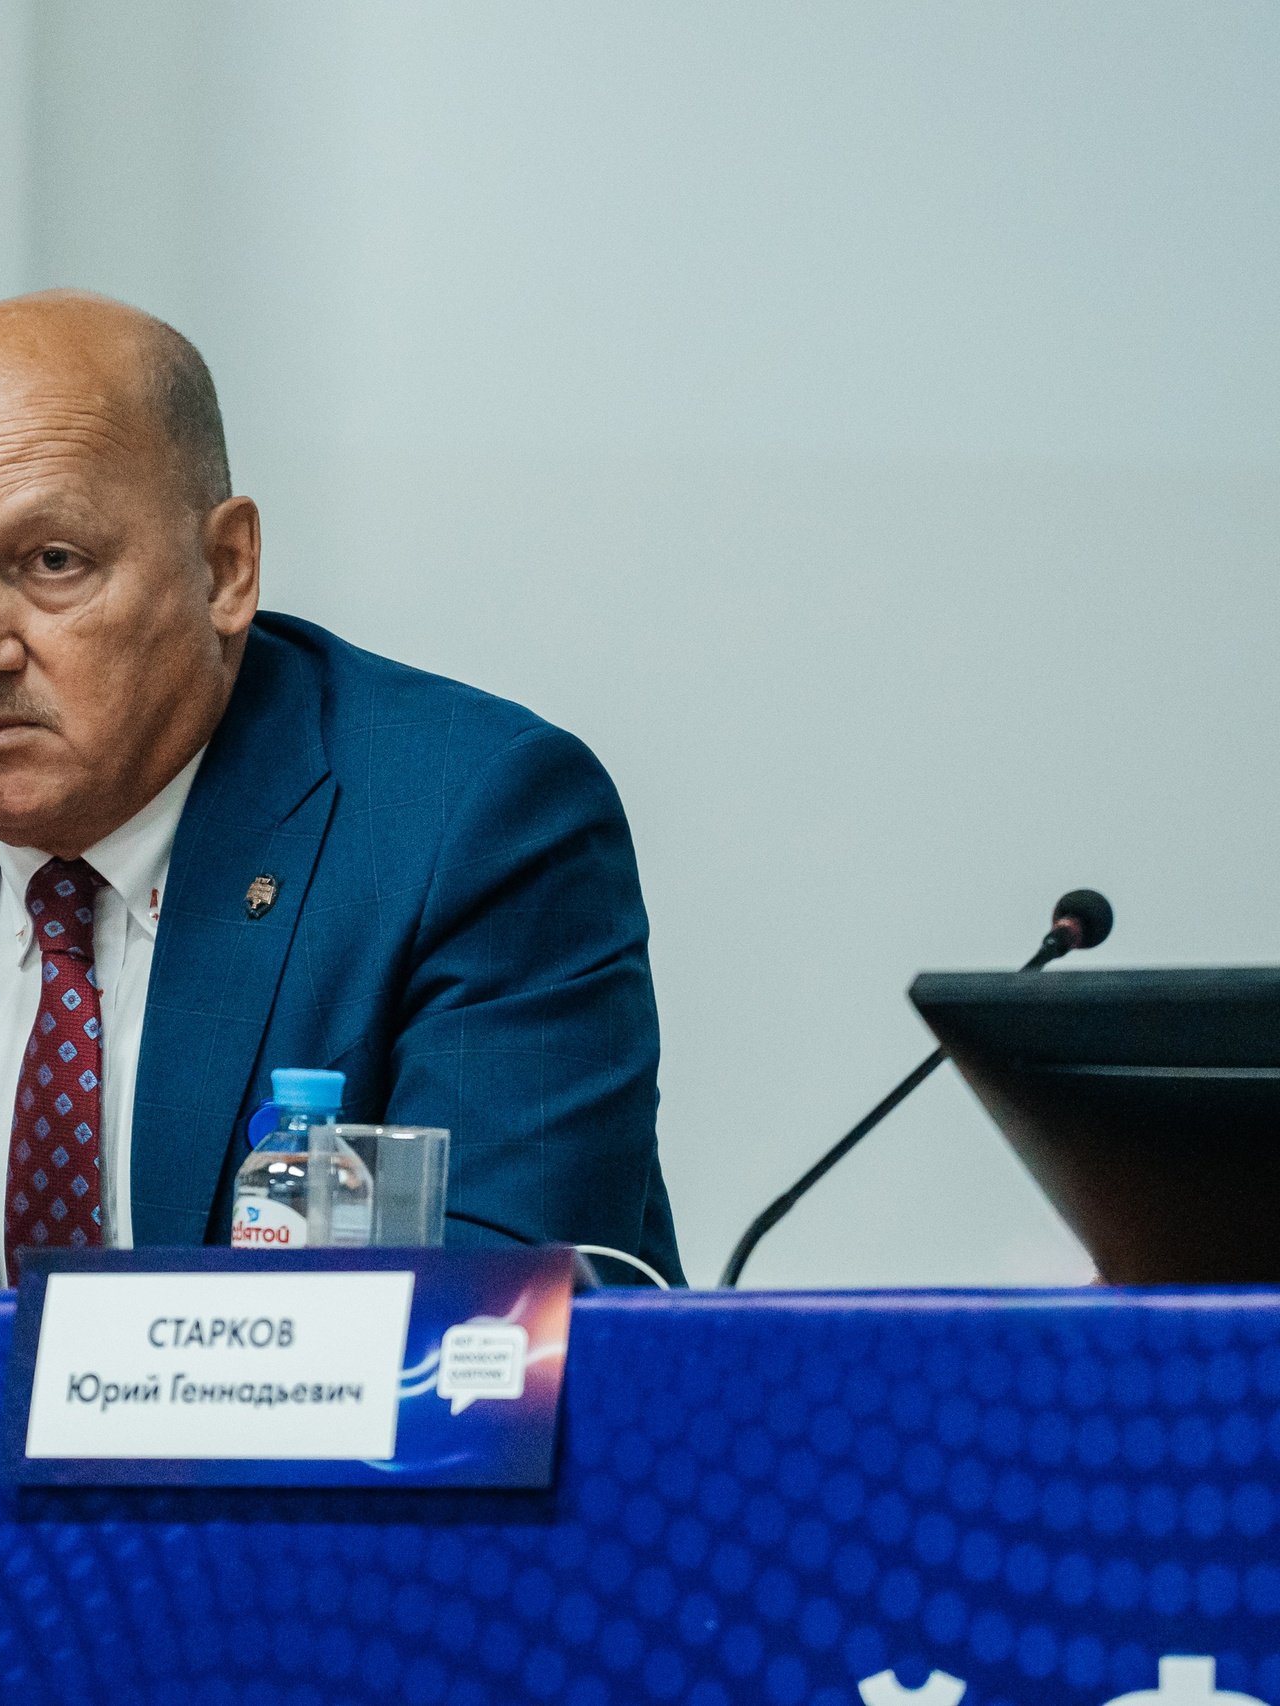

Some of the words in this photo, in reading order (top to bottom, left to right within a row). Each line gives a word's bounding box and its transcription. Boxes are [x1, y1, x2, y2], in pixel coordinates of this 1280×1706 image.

[148, 1317, 295, 1348] СТАРКОВ
[66, 1372, 160, 1413] Юрий
[170, 1373, 364, 1407] Геннадьевич
